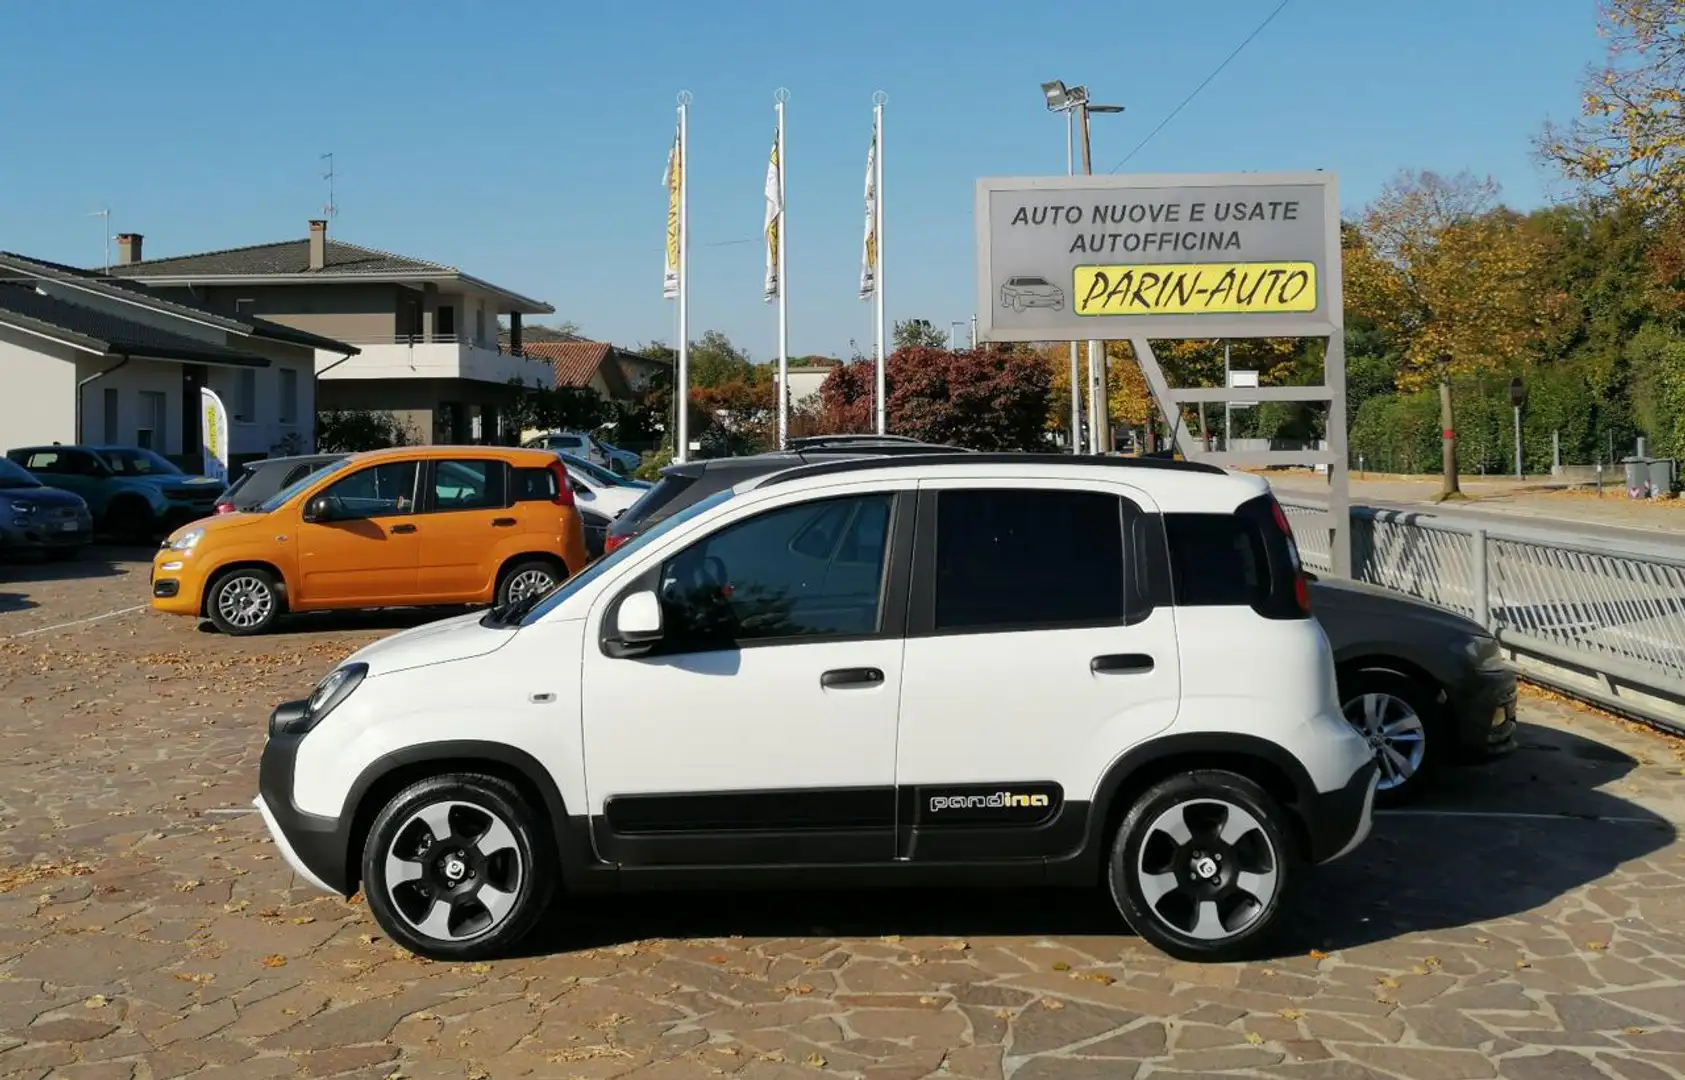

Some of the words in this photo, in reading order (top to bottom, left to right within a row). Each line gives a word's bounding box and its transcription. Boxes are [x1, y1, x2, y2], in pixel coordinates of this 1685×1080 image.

[1011, 205, 1082, 226] AUTO
[1091, 203, 1180, 224] NUOVE
[1189, 202, 1205, 222] E
[1214, 201, 1299, 222] USATE
[1069, 231, 1241, 254] AUTOFFICINA
[1082, 267, 1309, 311] PARIN-AUTO
[930, 792, 1048, 812] pandina
